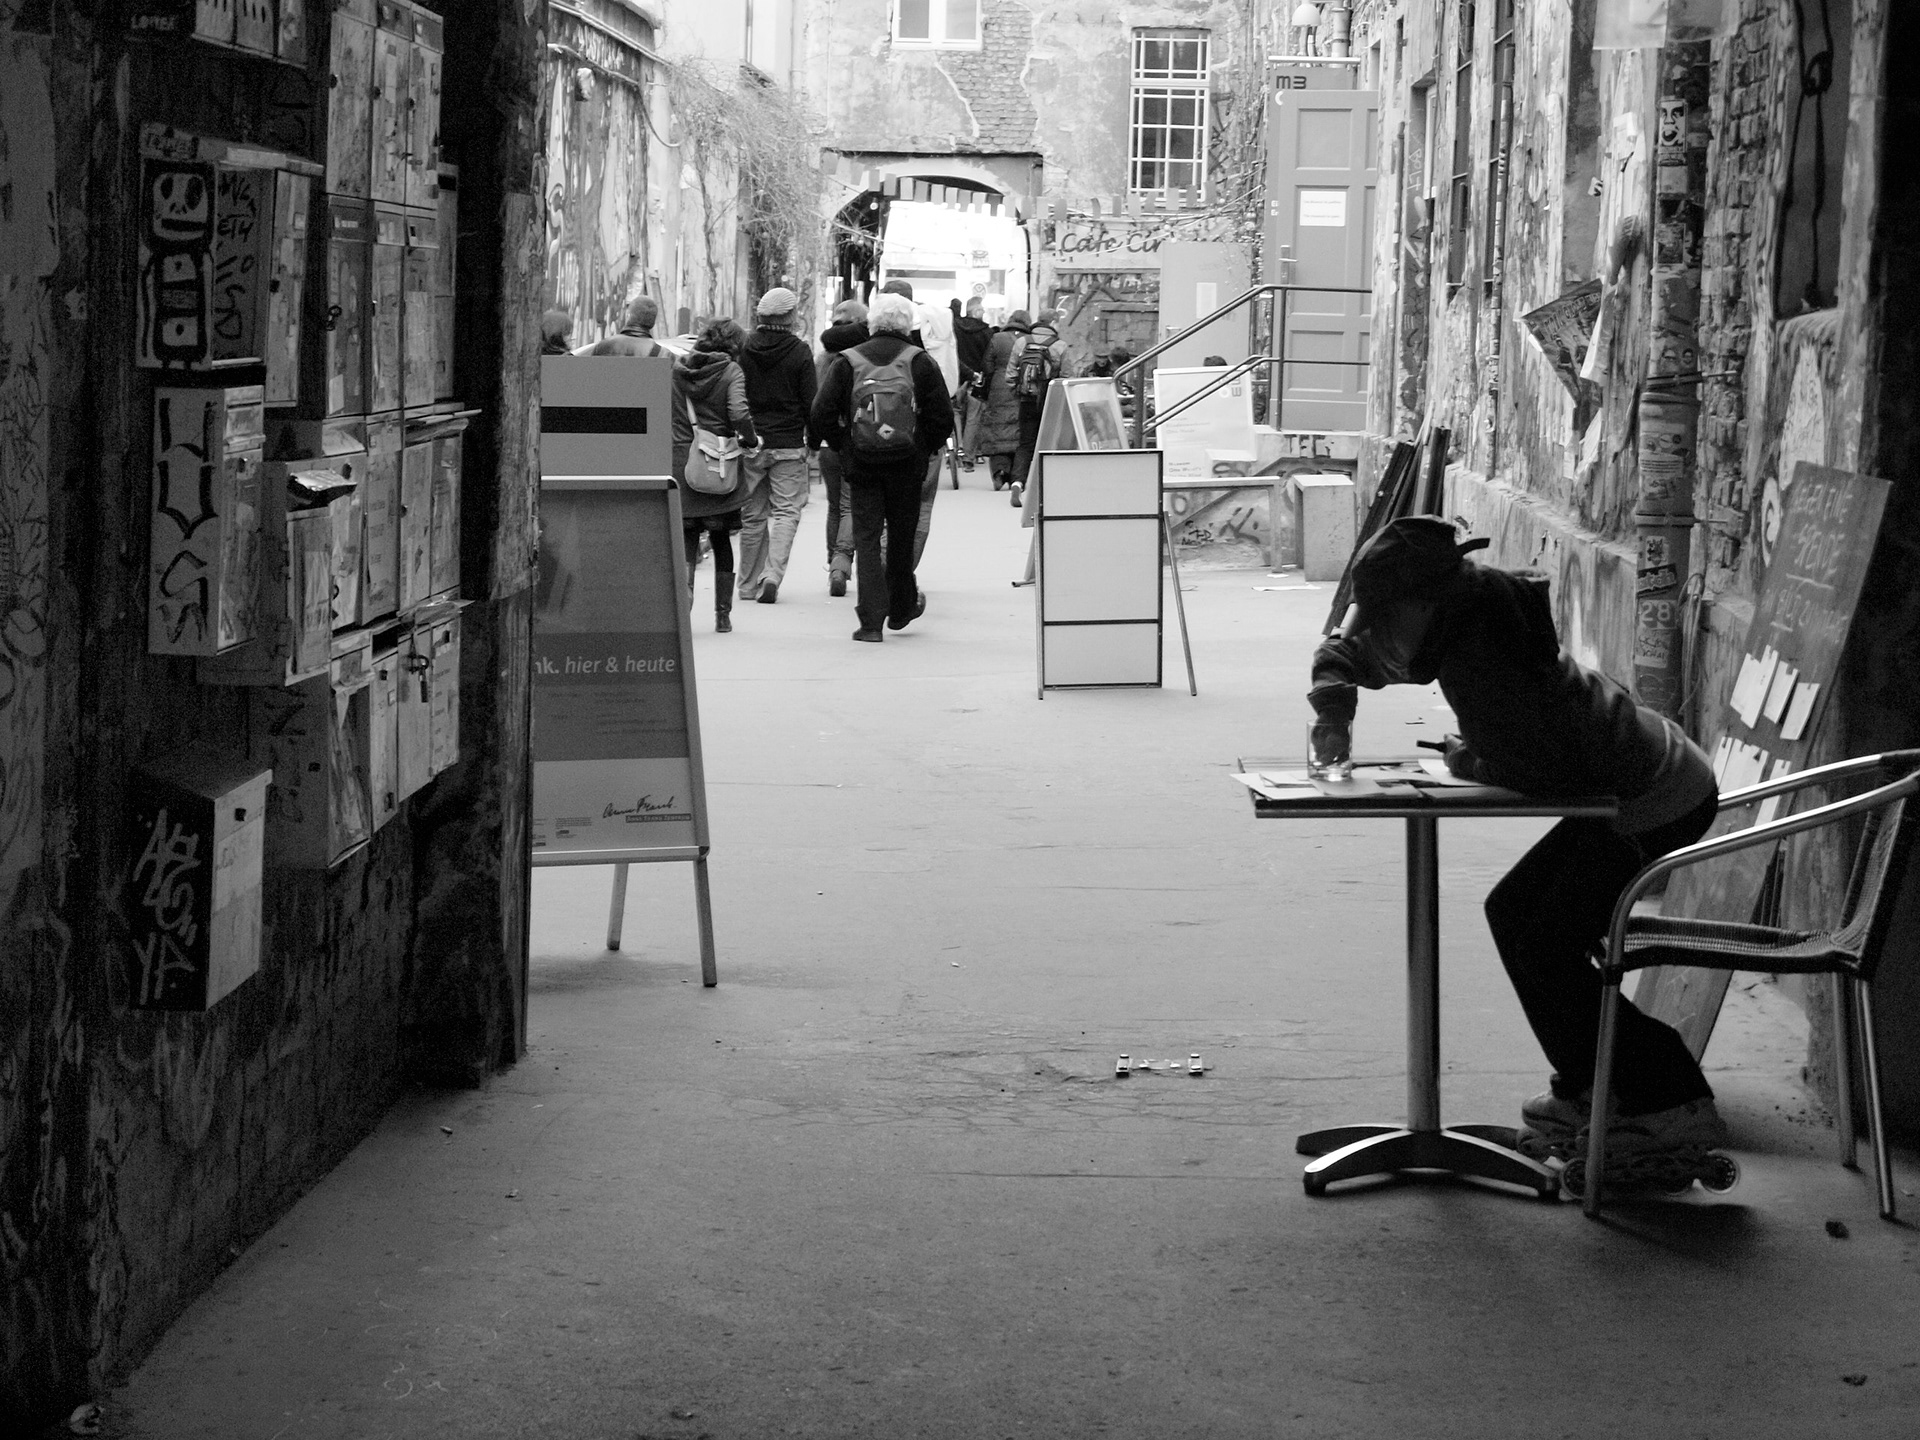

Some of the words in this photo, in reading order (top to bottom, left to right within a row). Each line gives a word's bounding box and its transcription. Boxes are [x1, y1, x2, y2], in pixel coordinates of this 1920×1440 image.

[1641, 601, 1671, 622] 28
[565, 656, 601, 674] hier
[605, 656, 619, 674] &
[625, 655, 675, 673] heute
